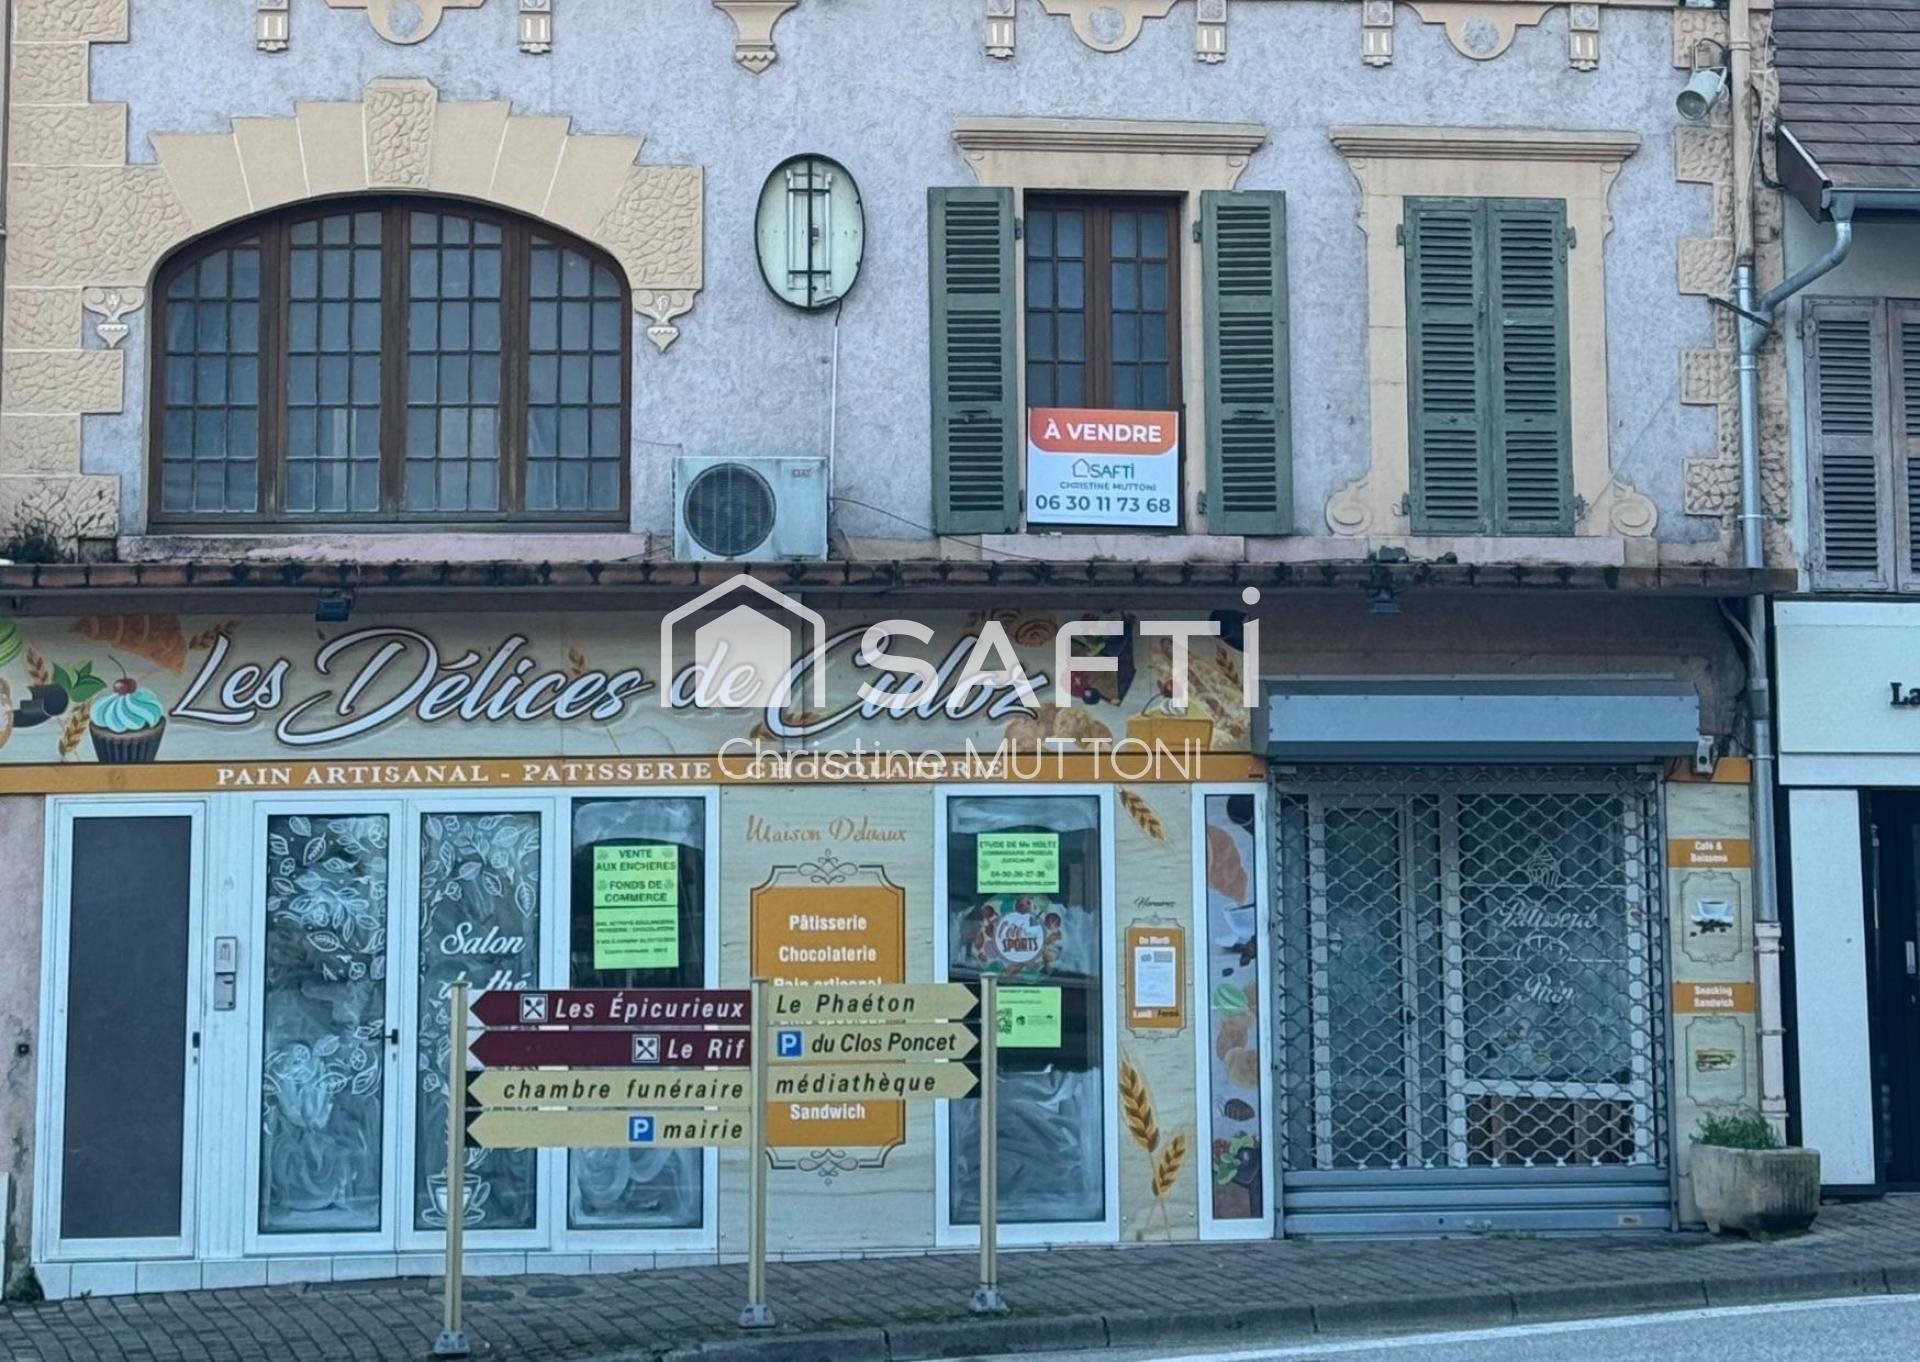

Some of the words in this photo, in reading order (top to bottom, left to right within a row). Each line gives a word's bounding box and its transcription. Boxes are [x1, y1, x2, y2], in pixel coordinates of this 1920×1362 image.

[1044, 418, 1061, 439] À
[1067, 423, 1162, 443] VENDRE
[1060, 481, 1110, 490] CHRISTINE
[1112, 482, 1157, 491] MUTTONI
[1036, 495, 1060, 510] 06
[1066, 495, 1090, 511] 30
[1096, 496, 1110, 511] 11
[1117, 497, 1140, 512] 73
[1146, 498, 1170, 513] 68
[170, 632, 290, 725] Les
[276, 627, 654, 745] Délices
[670, 638, 762, 708] de
[765, 625, 1050, 738] Culoz
[217, 767, 292, 786] PAIN
[303, 764, 488, 785] ARTISANAL
[523, 761, 712, 782] PATISSERIE
[618, 849, 652, 859] VENTE
[596, 862, 617, 872] AUX
[620, 861, 677, 871] ENCHERES
[609, 880, 645, 890] FONDS
[648, 880, 662, 889] DE
[604, 893, 667, 903] COMMERCE
[789, 914, 867, 931] Pâtisserie
[440, 921, 526, 955] Salon
[779, 945, 877, 962] Chocolaterie
[555, 998, 595, 1018] Les
[609, 992, 744, 1023] Épicurieux
[776, 994, 801, 1014] Le
[816, 993, 915, 1014] Phaéton
[668, 1038, 693, 1059] Le
[707, 1038, 745, 1059] Rif
[812, 1034, 835, 1053] du
[840, 1033, 882, 1053] Clos
[888, 1032, 957, 1052] Poncet
[503, 1079, 611, 1099] chambre
[626, 1078, 743, 1099] funéraire
[776, 1072, 936, 1097] médiathèque
[790, 1103, 866, 1120] Sandwich
[662, 1119, 743, 1139] mairie
